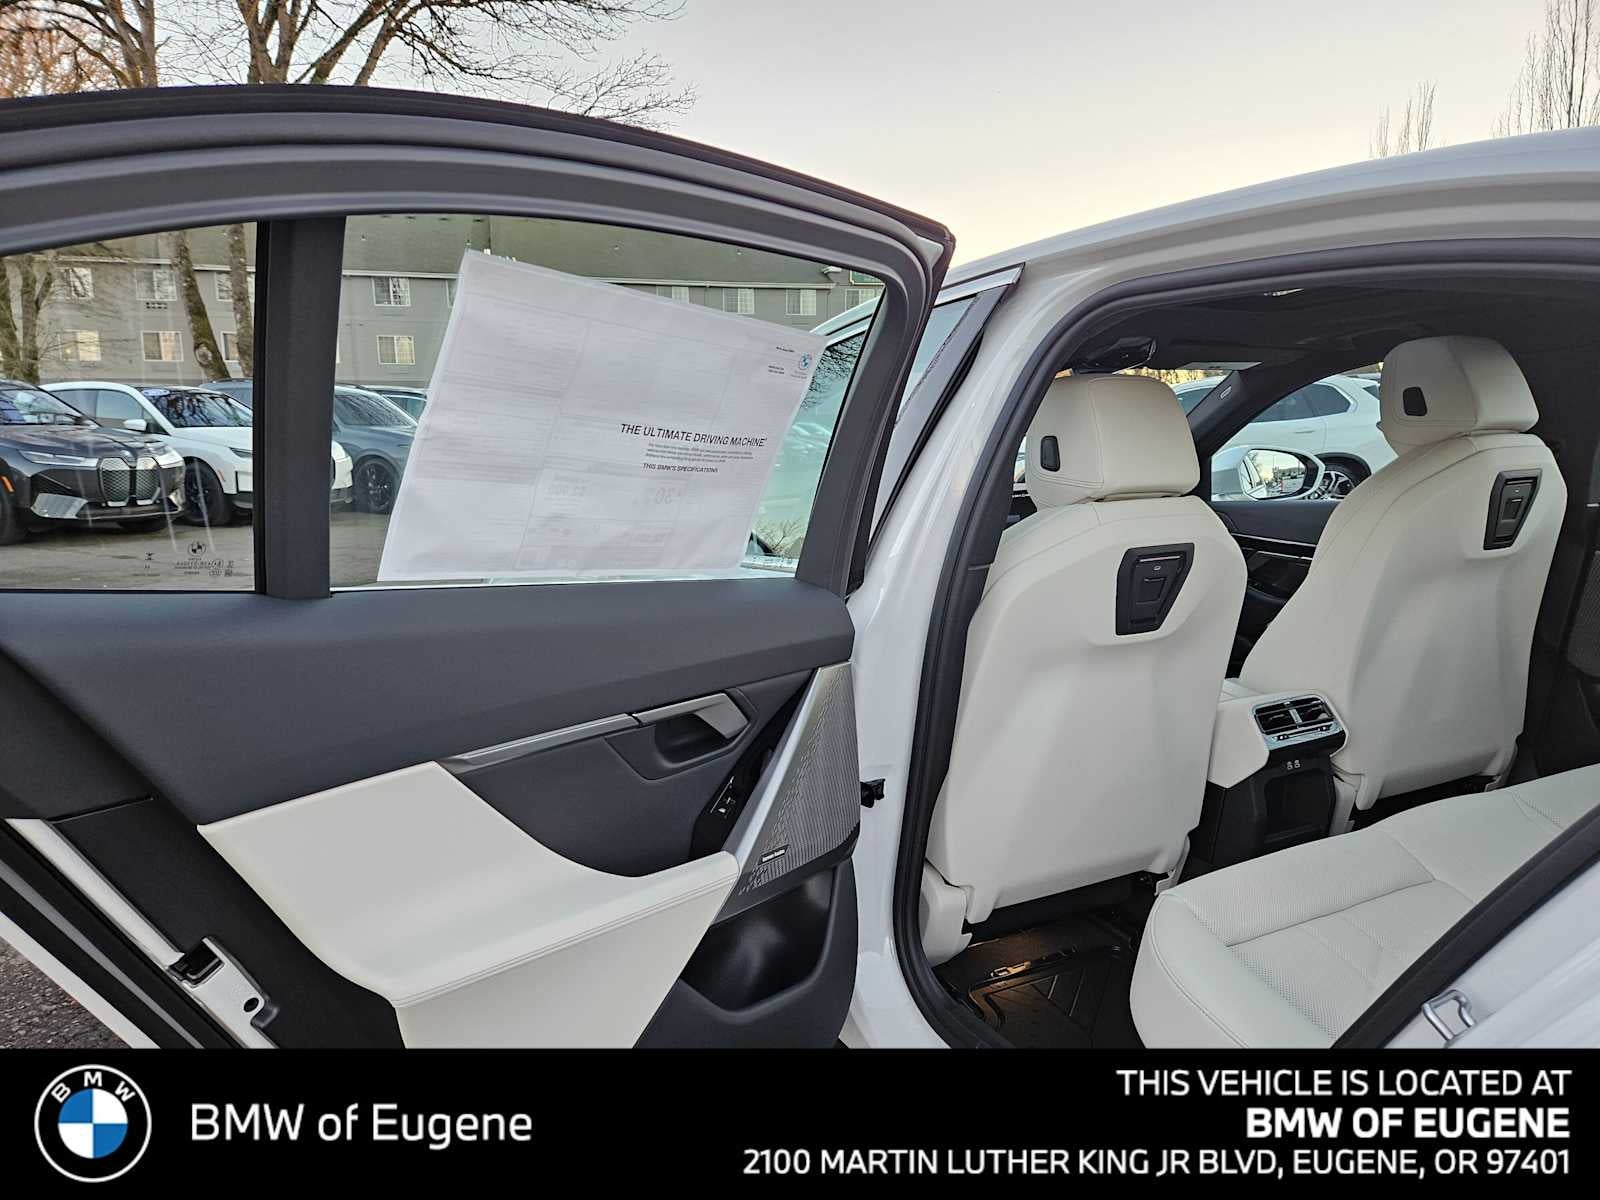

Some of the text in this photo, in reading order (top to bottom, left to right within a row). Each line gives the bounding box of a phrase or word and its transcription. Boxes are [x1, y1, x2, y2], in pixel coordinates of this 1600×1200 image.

[620, 423, 641, 436] THE
[643, 425, 693, 442] ULTIMATE
[693, 433, 729, 445] DRIVING
[643, 463, 656, 471] THIS
[677, 465, 719, 473] SPECIFICATIONS
